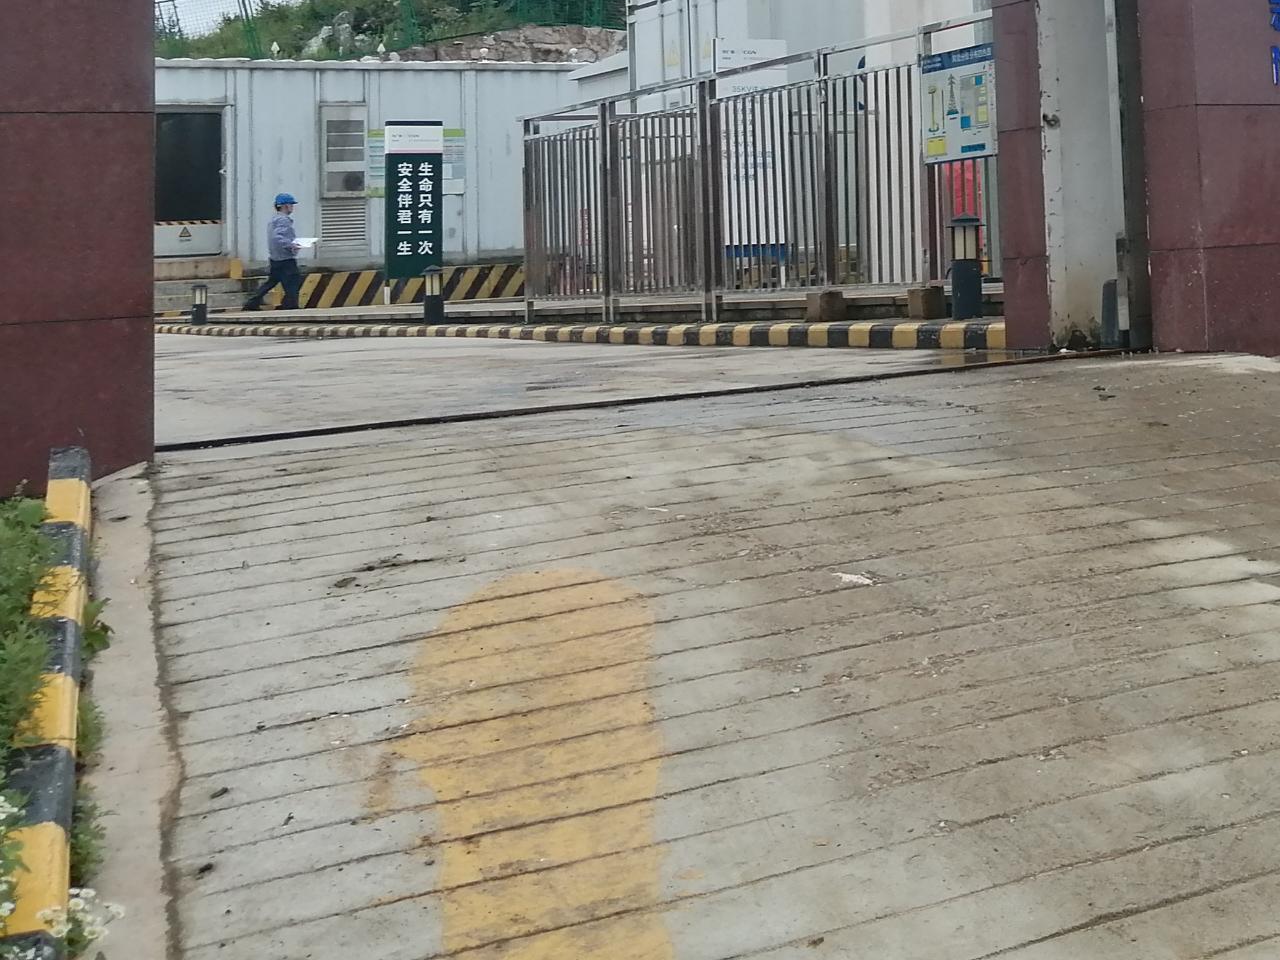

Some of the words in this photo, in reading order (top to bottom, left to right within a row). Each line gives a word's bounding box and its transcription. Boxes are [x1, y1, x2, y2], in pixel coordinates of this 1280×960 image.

[396, 161, 414, 256] 安全伴君一生
[417, 161, 435, 256] 生命只有一次
